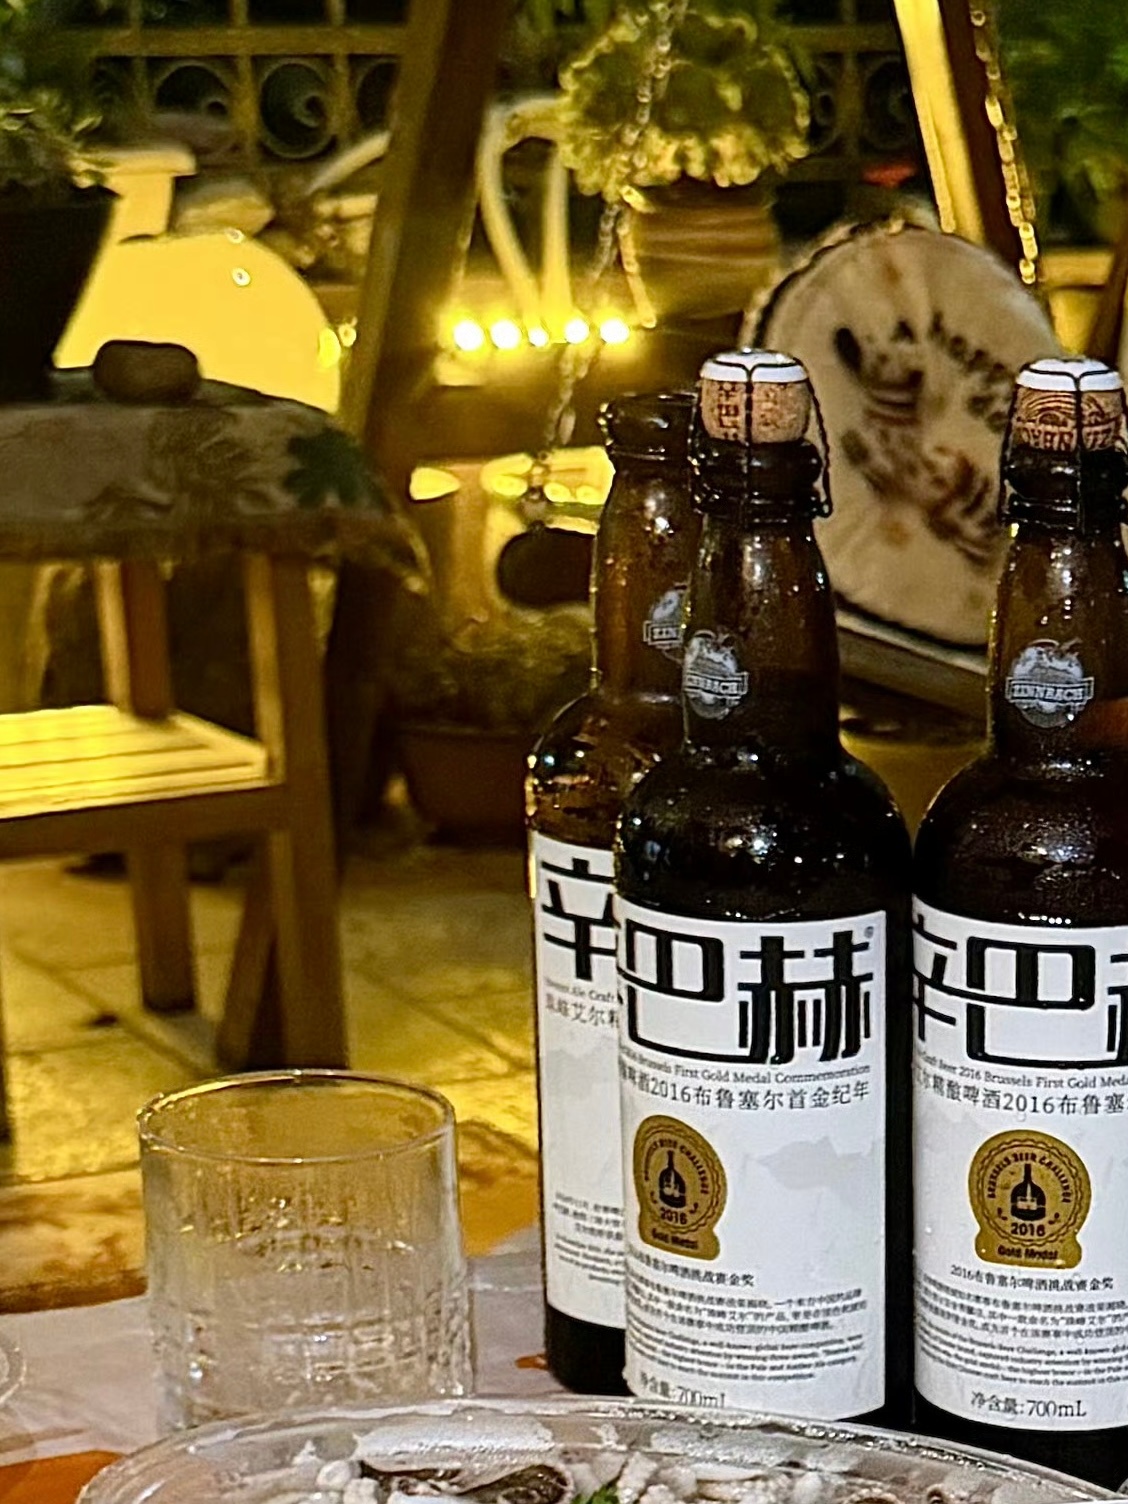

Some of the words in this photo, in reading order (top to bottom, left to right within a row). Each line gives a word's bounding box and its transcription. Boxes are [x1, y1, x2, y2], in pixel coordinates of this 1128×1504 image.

[674, 1064, 700, 1080] First
[701, 1068, 730, 1083] Gold
[733, 1071, 771, 1084] Medal
[984, 1070, 1033, 1088] Brussels
[1036, 1075, 1064, 1088] First
[1067, 1076, 1096, 1089] Gold
[1010, 1221, 1046, 1238] 2016
[970, 1390, 1088, 1418] 净含量:700mL
